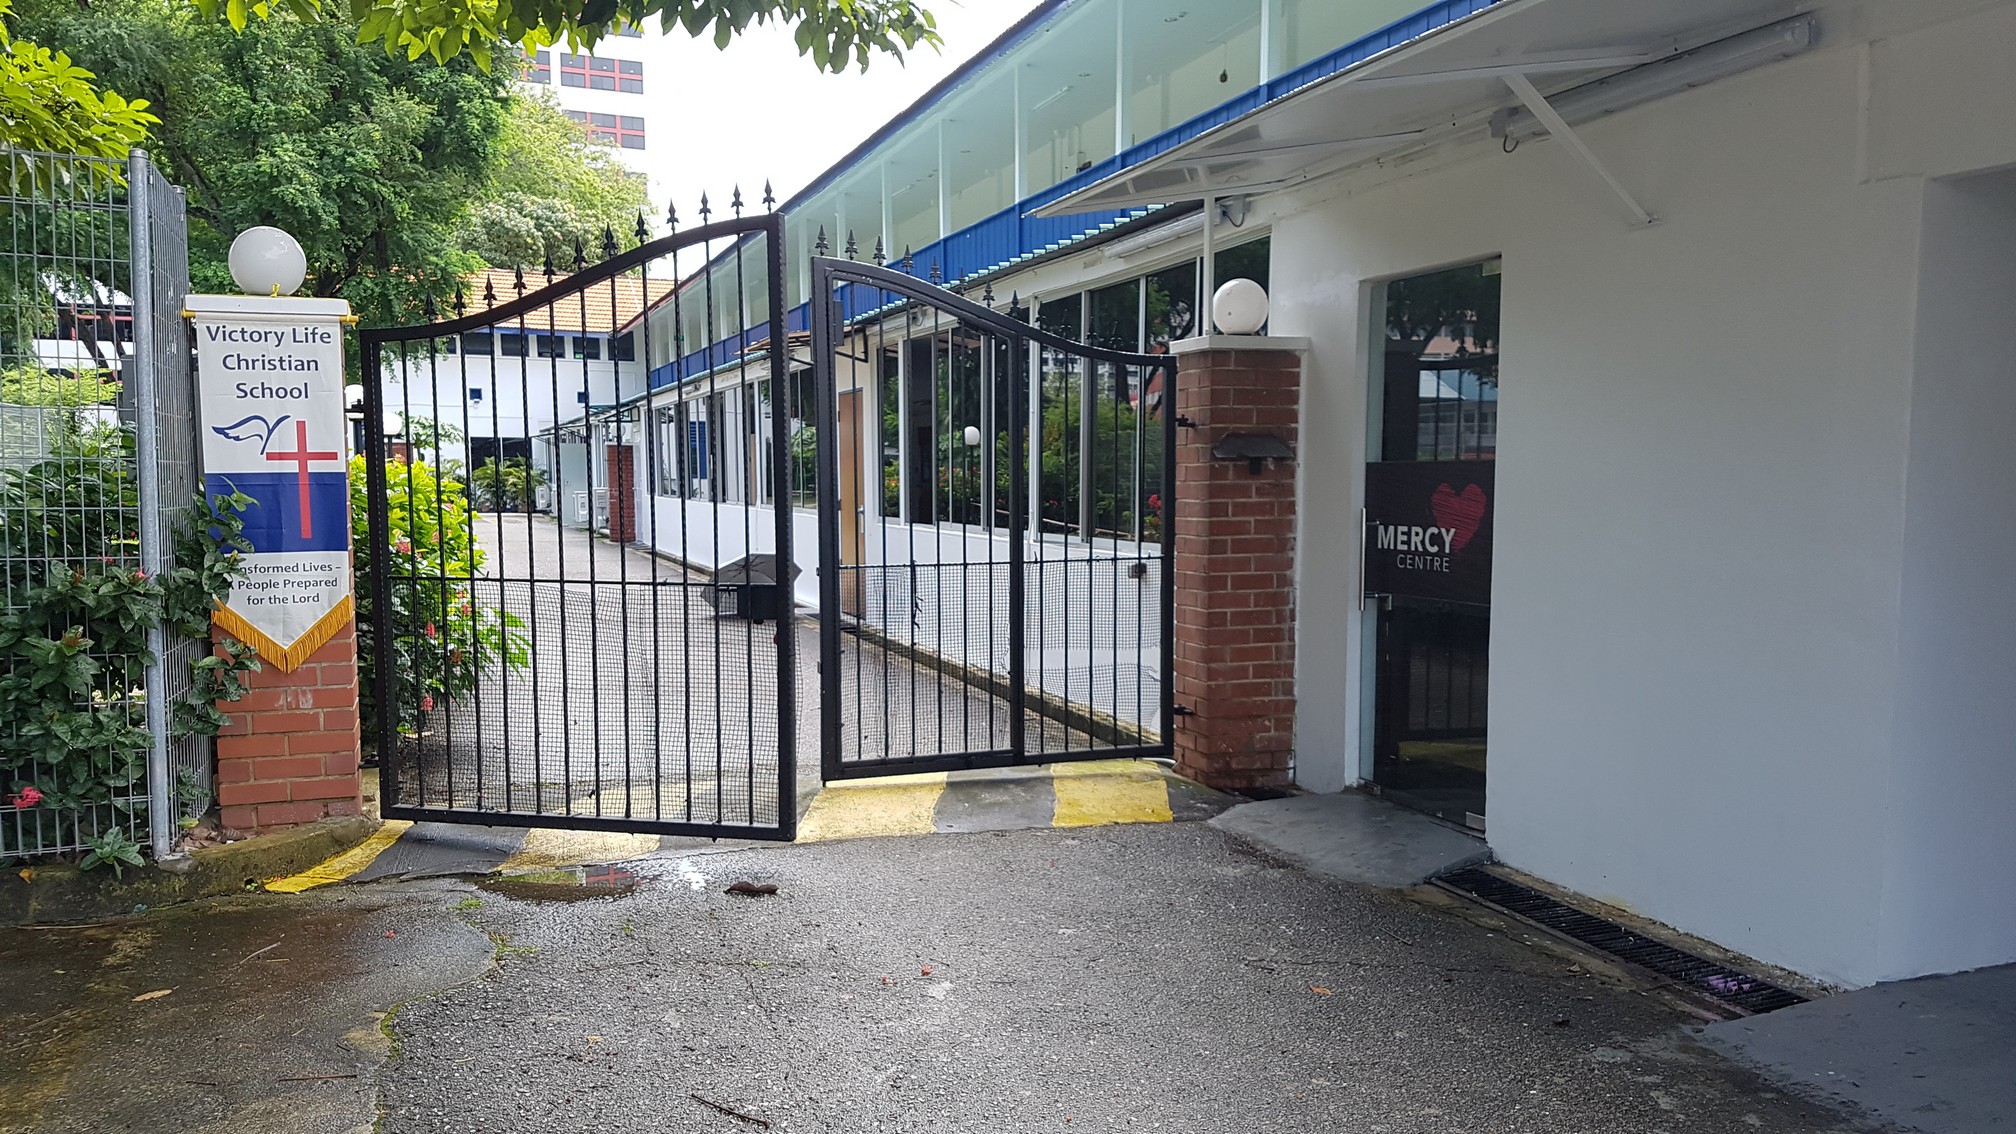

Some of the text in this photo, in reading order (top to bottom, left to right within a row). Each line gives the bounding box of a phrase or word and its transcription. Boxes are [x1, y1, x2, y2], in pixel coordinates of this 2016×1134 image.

[205, 324, 332, 348] Victory Life
[222, 353, 319, 372] Christian
[236, 381, 309, 399] School
[1377, 524, 1456, 554] MERCY
[240, 563, 299, 575] nsformed
[302, 562, 333, 573] Lives
[1396, 553, 1450, 572] CENTRE
[238, 579, 280, 592] People
[283, 577, 338, 590] Prepared
[247, 593, 320, 606] for the Lord
